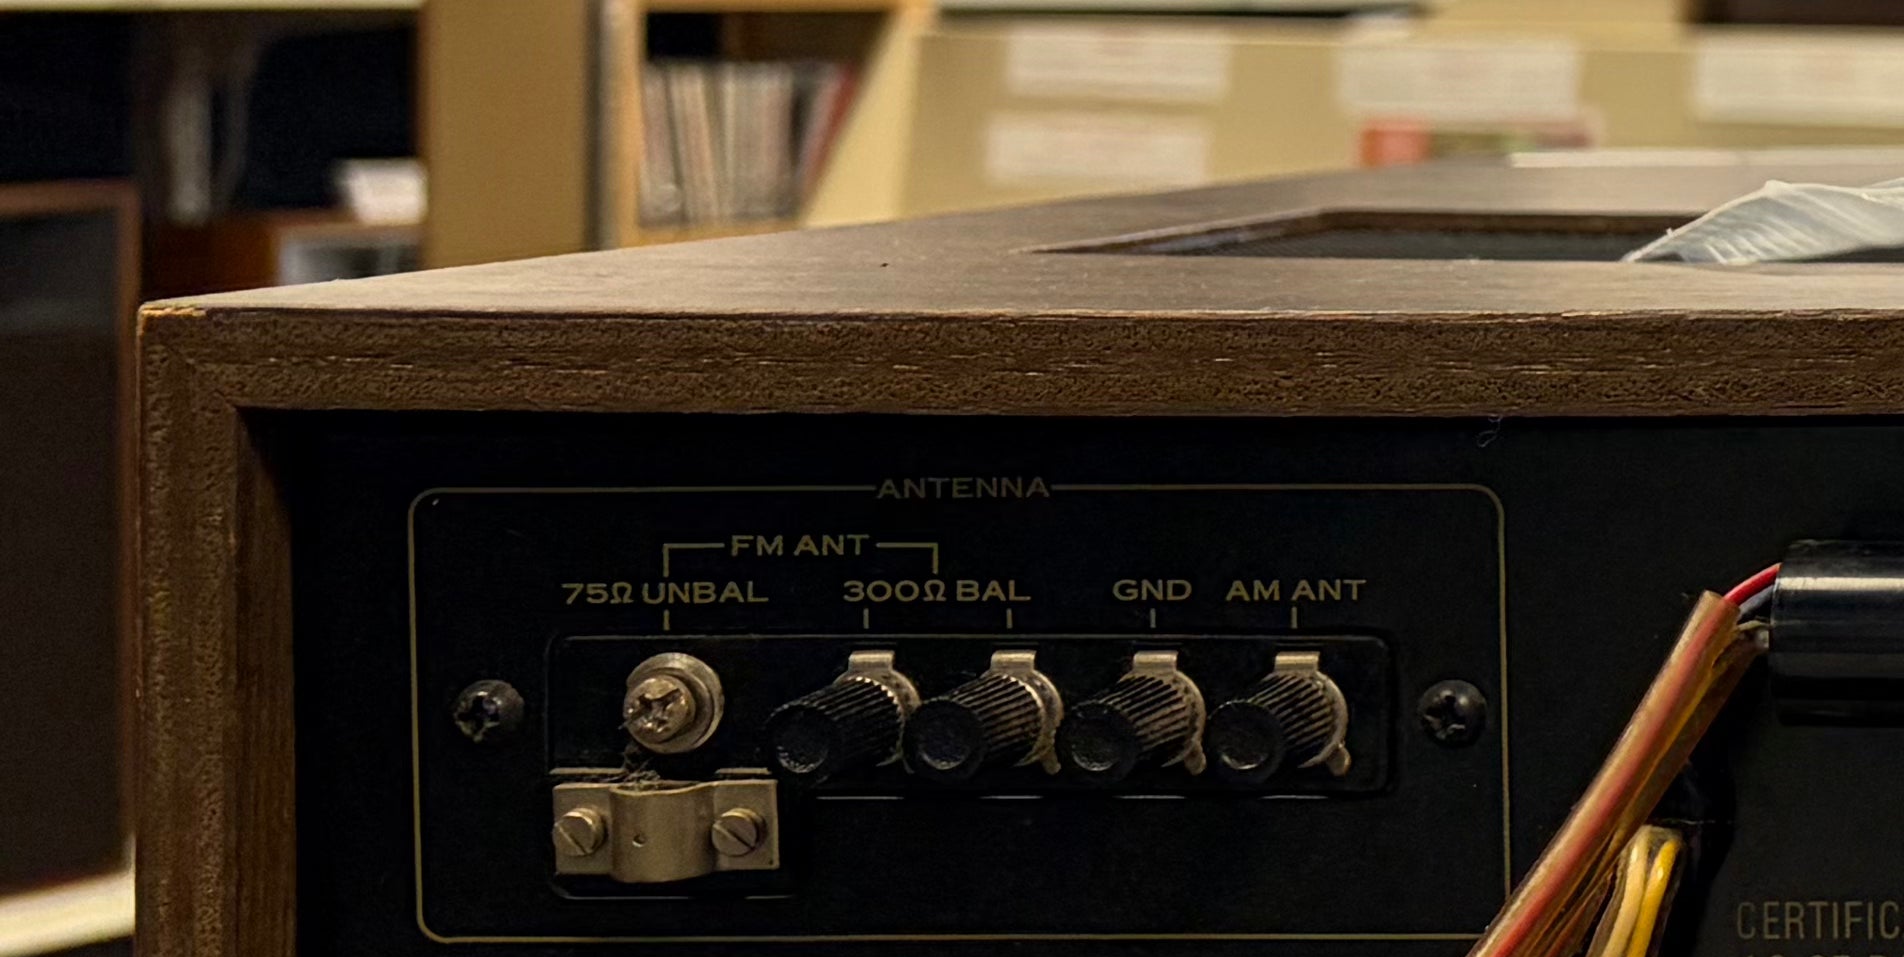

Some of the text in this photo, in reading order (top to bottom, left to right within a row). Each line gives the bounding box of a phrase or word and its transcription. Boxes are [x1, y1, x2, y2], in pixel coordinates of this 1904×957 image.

[876, 476, 1051, 500] ANTENNA
[731, 533, 870, 557] FM ANT
[561, 580, 769, 605] 75Ω UNBAL
[843, 578, 1032, 603] 300Ω BAL
[1112, 578, 1193, 601] GND
[1225, 578, 1367, 602] AM ANT
